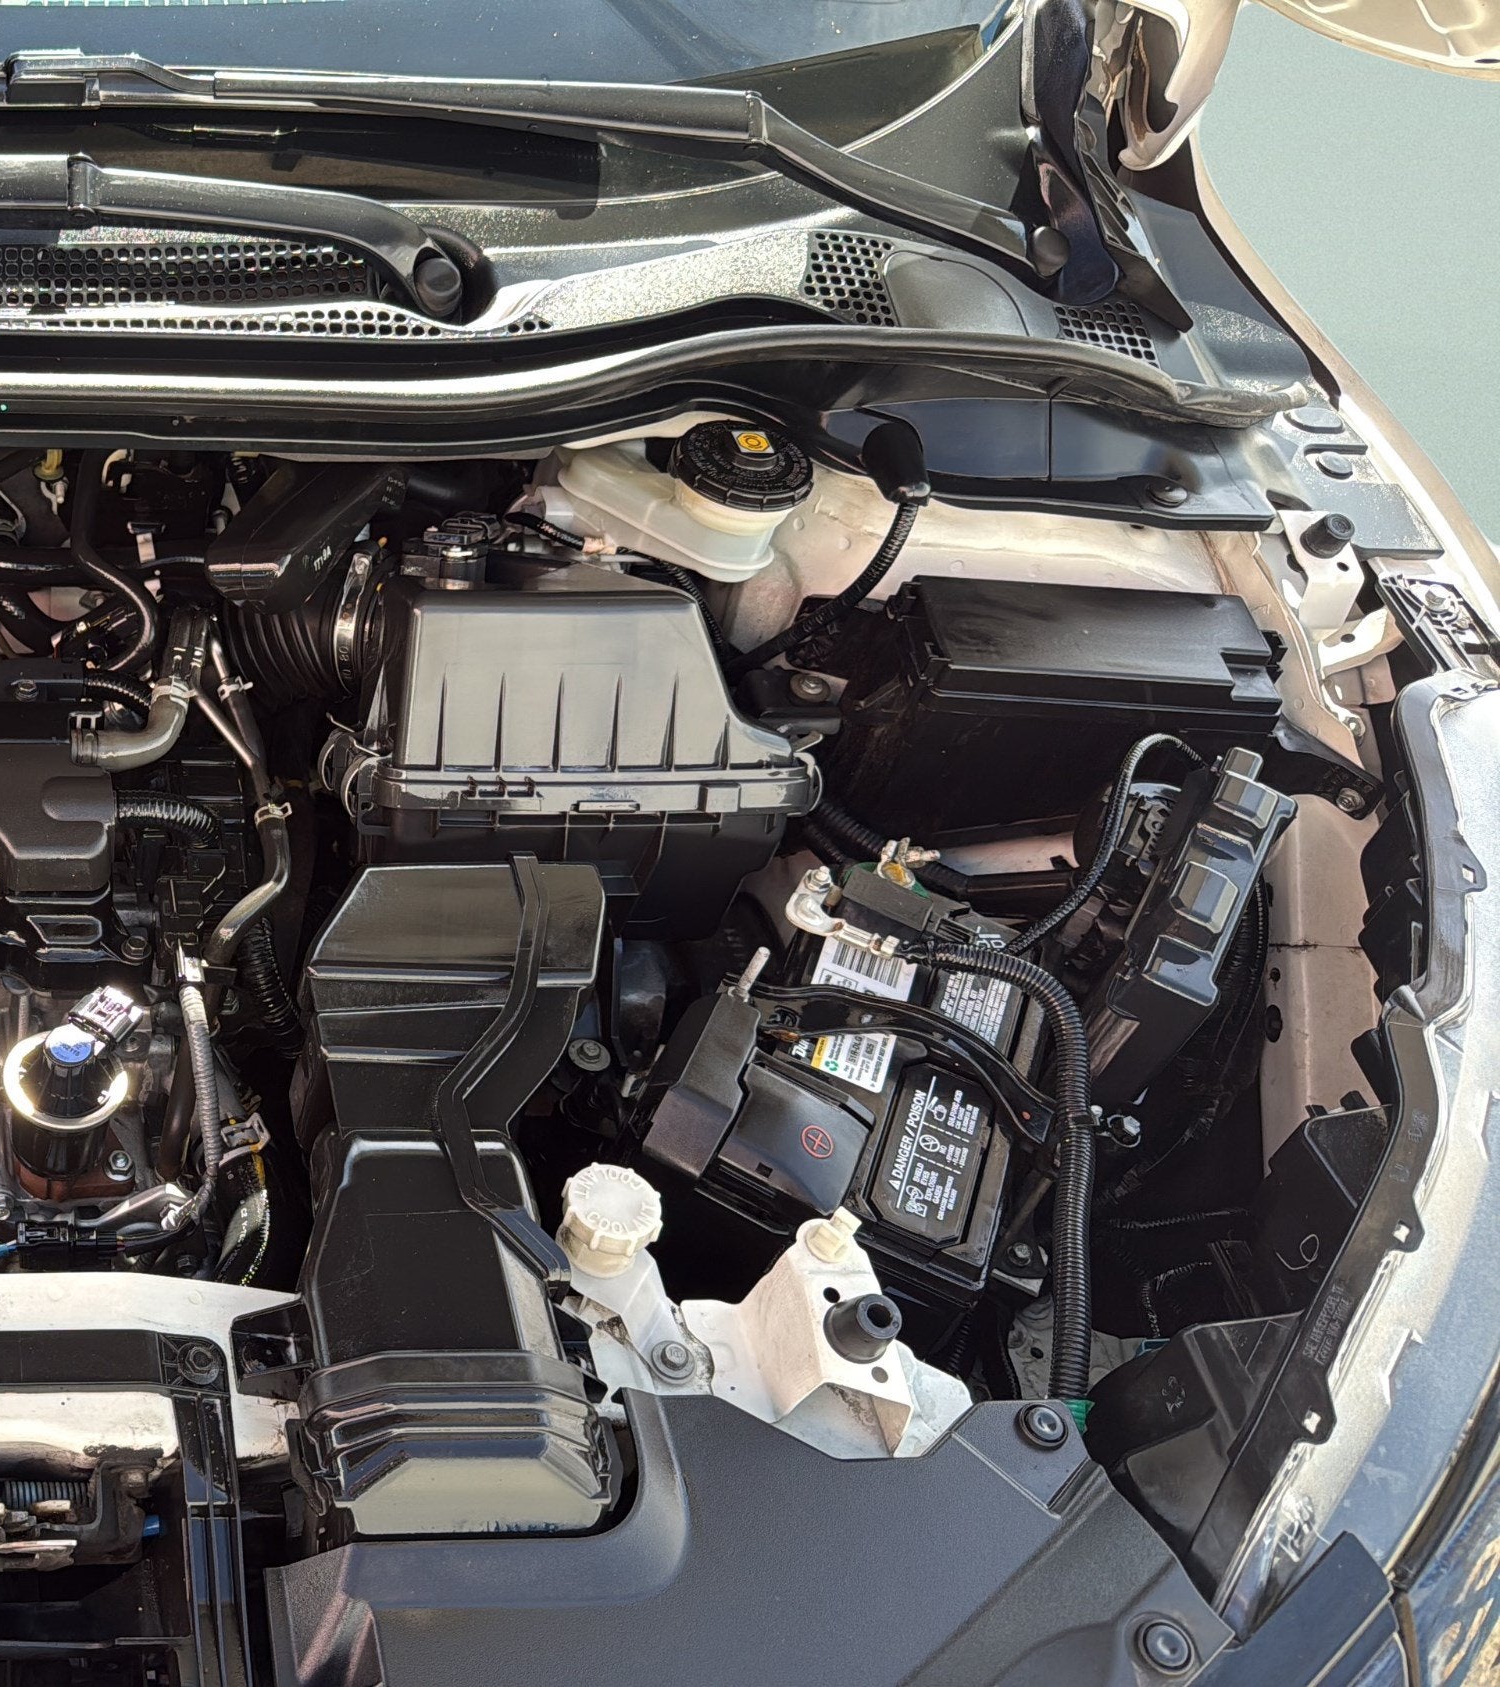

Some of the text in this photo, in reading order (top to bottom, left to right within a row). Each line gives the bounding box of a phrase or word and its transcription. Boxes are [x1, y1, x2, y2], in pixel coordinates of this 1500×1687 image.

[864, 1042, 874, 1054] 625
[891, 1134, 913, 1178] DANGER
[906, 1089, 926, 1127] POISON
[574, 1168, 643, 1200] COOLANT
[587, 1202, 657, 1236] COOLANT
